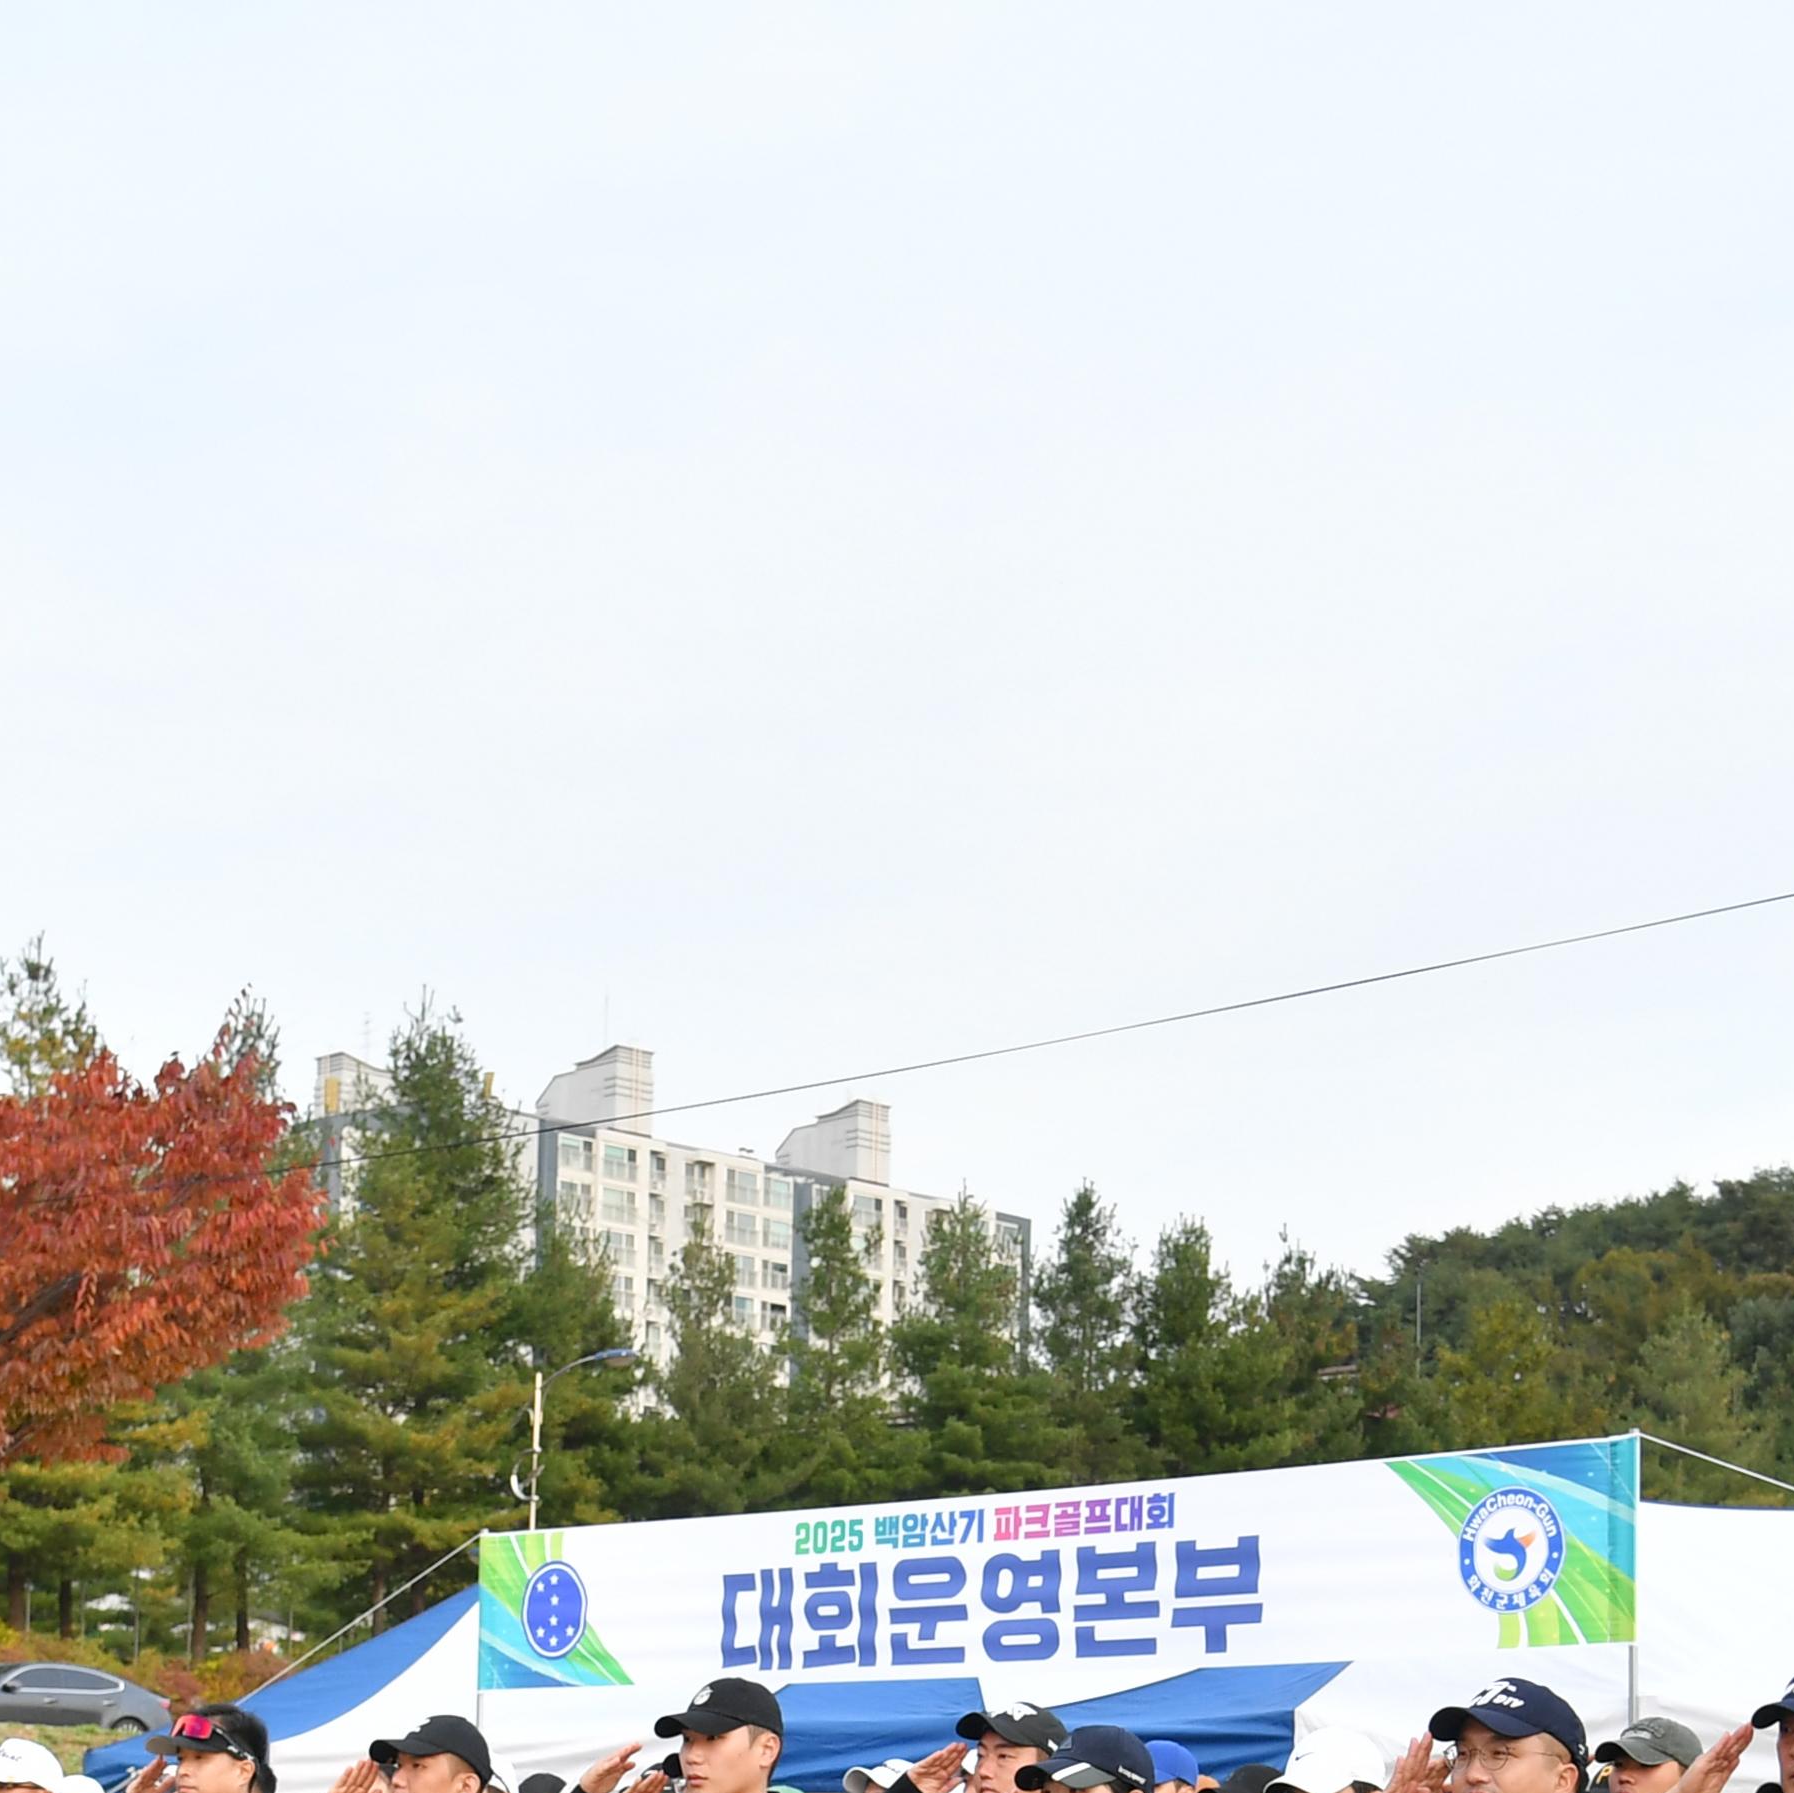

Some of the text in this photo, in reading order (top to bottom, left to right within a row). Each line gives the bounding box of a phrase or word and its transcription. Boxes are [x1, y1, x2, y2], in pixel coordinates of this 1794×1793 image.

[795, 1492, 1176, 1555] 2025 백암산기 파크골프대회
[1463, 1493, 1557, 1542] HwaCheon-Gun
[721, 1534, 1264, 1670] 대회운영본부
